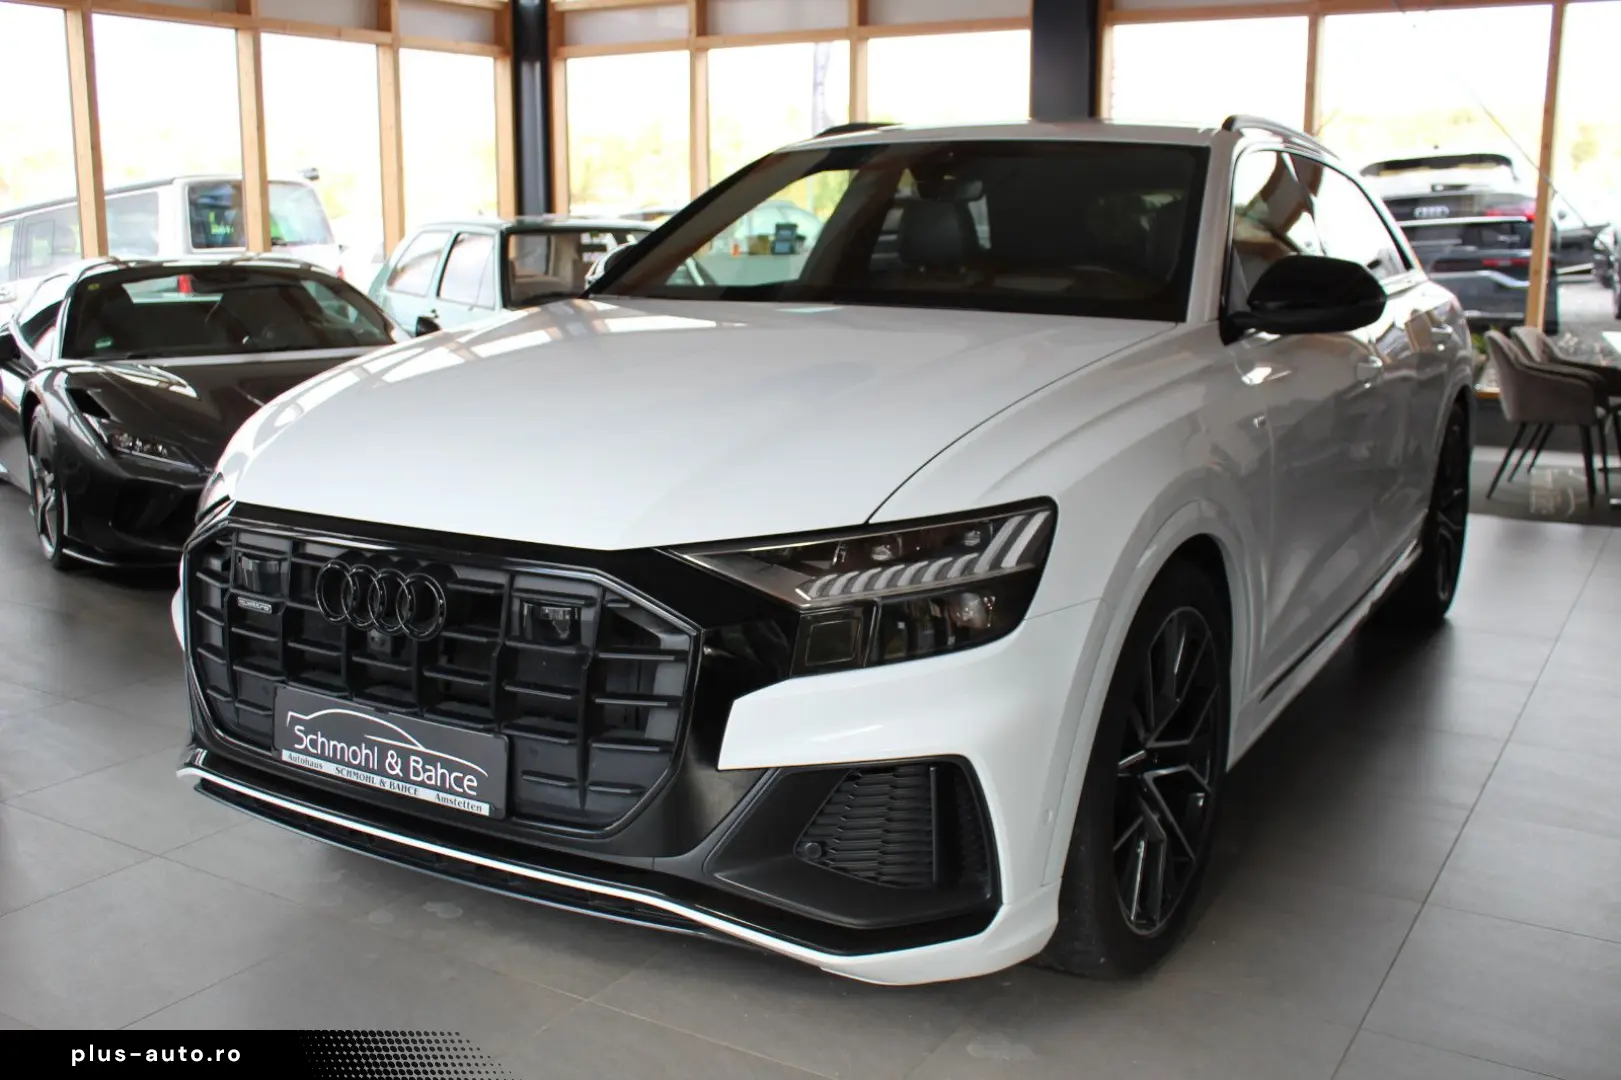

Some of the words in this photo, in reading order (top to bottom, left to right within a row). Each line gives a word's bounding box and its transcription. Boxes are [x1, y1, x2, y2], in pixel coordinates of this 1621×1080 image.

[287, 752, 323, 770] Autohaus
[334, 766, 377, 785] SCHMOHL
[379, 778, 387, 787] &
[389, 780, 420, 797] BAHCE
[434, 793, 483, 813] Amstetten
[294, 725, 378, 770] Schmohl
[385, 750, 403, 777] &
[409, 755, 478, 796] Bahce
